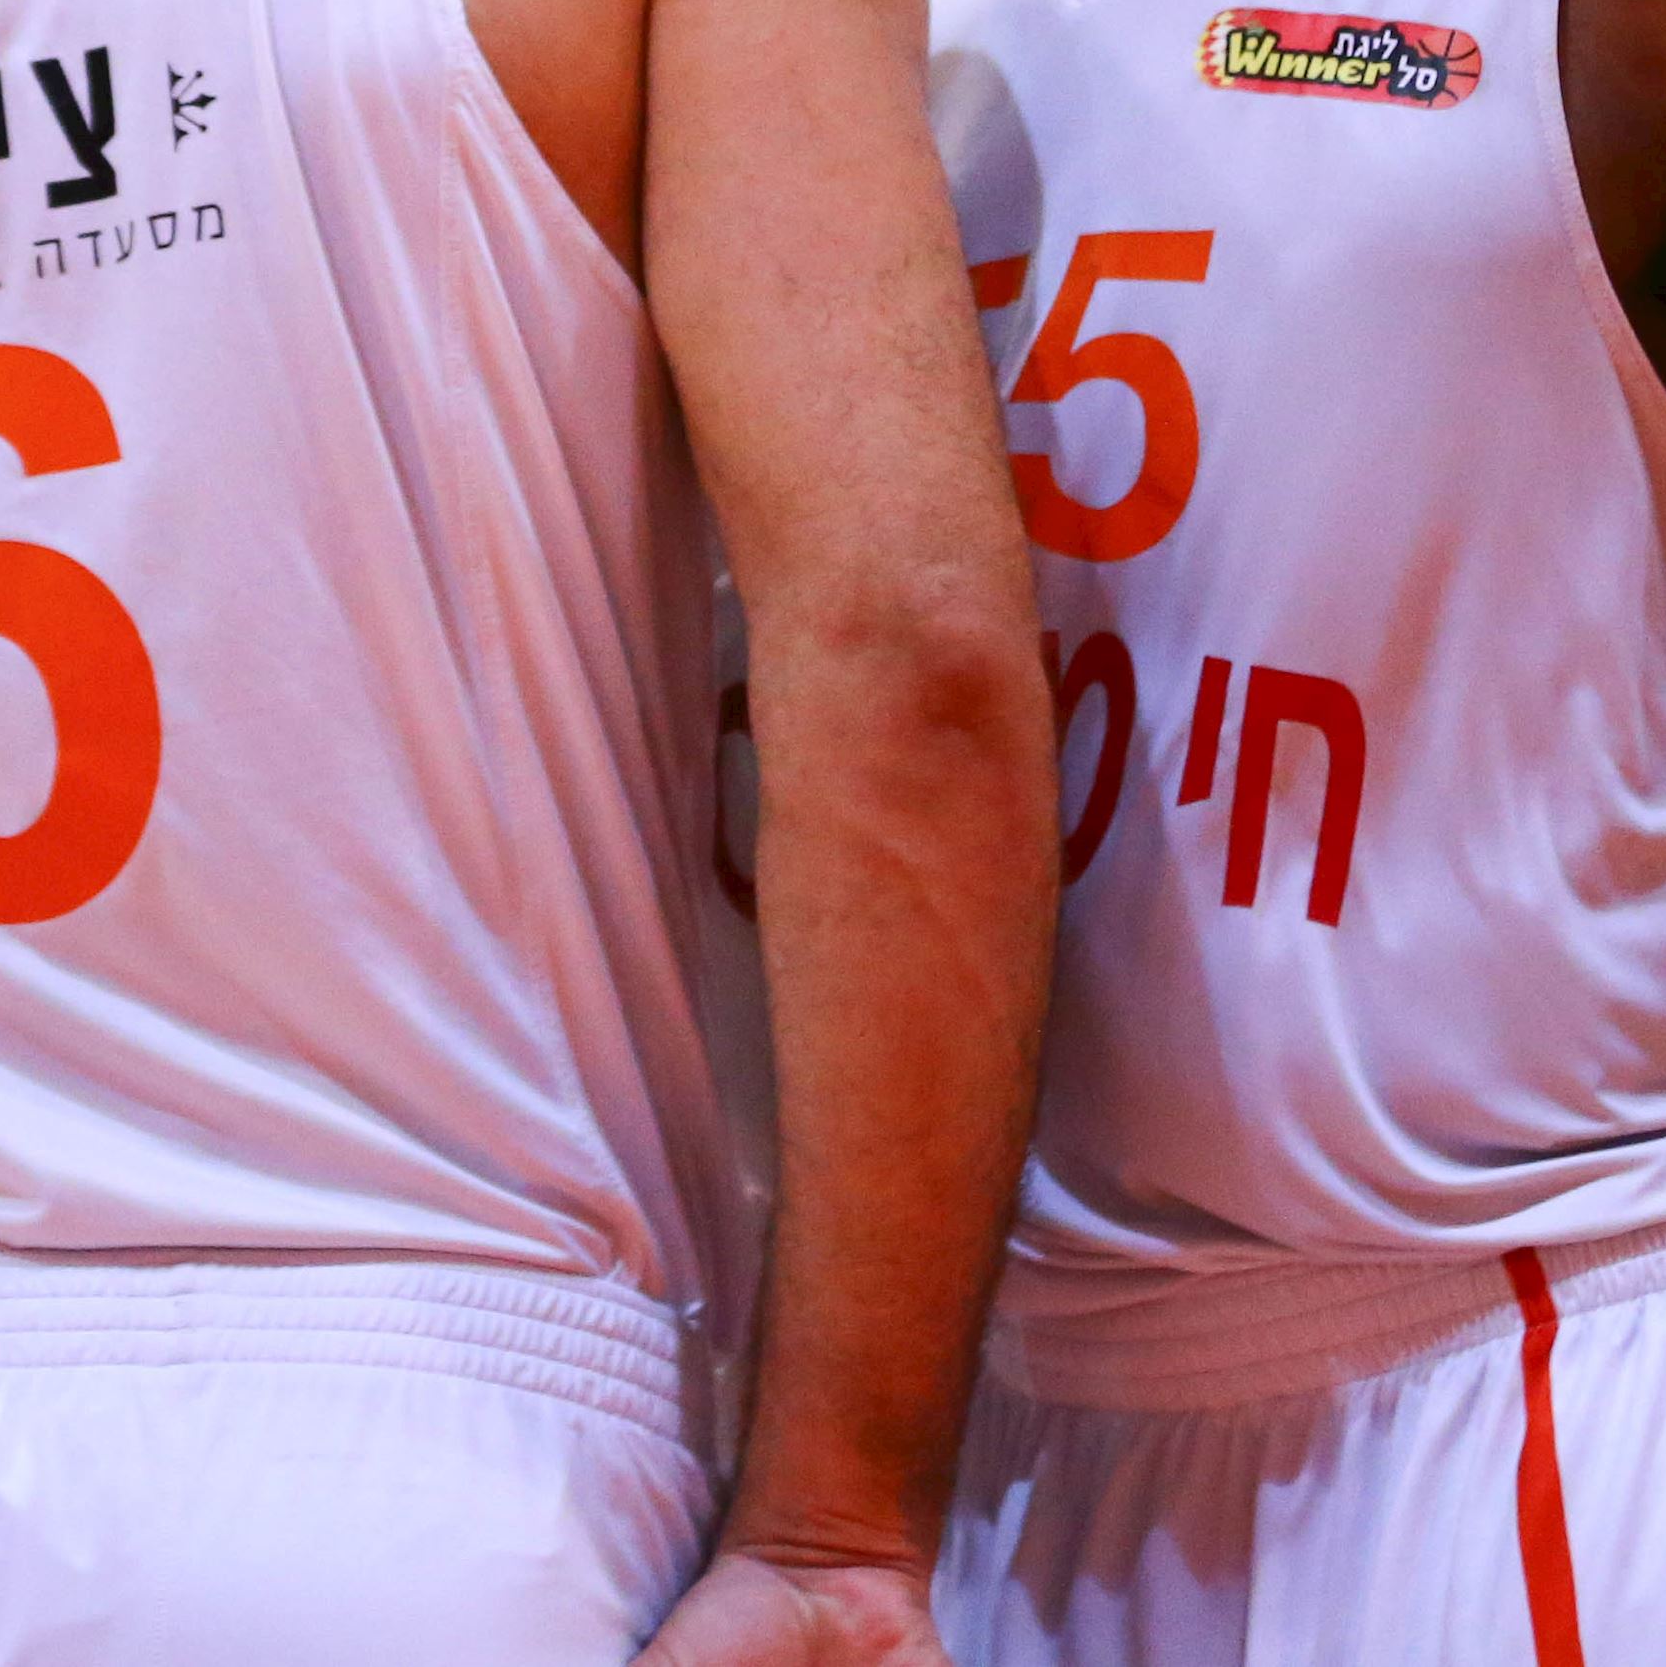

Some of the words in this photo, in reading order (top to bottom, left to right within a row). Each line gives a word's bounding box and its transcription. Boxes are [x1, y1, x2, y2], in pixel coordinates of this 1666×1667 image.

[1228, 32, 1391, 86] Winner
[1333, 29, 1398, 59] ליגת
[1396, 54, 1438, 92] סל
[32, 201, 227, 279] מסעדה
[970, 229, 1216, 563] 5
